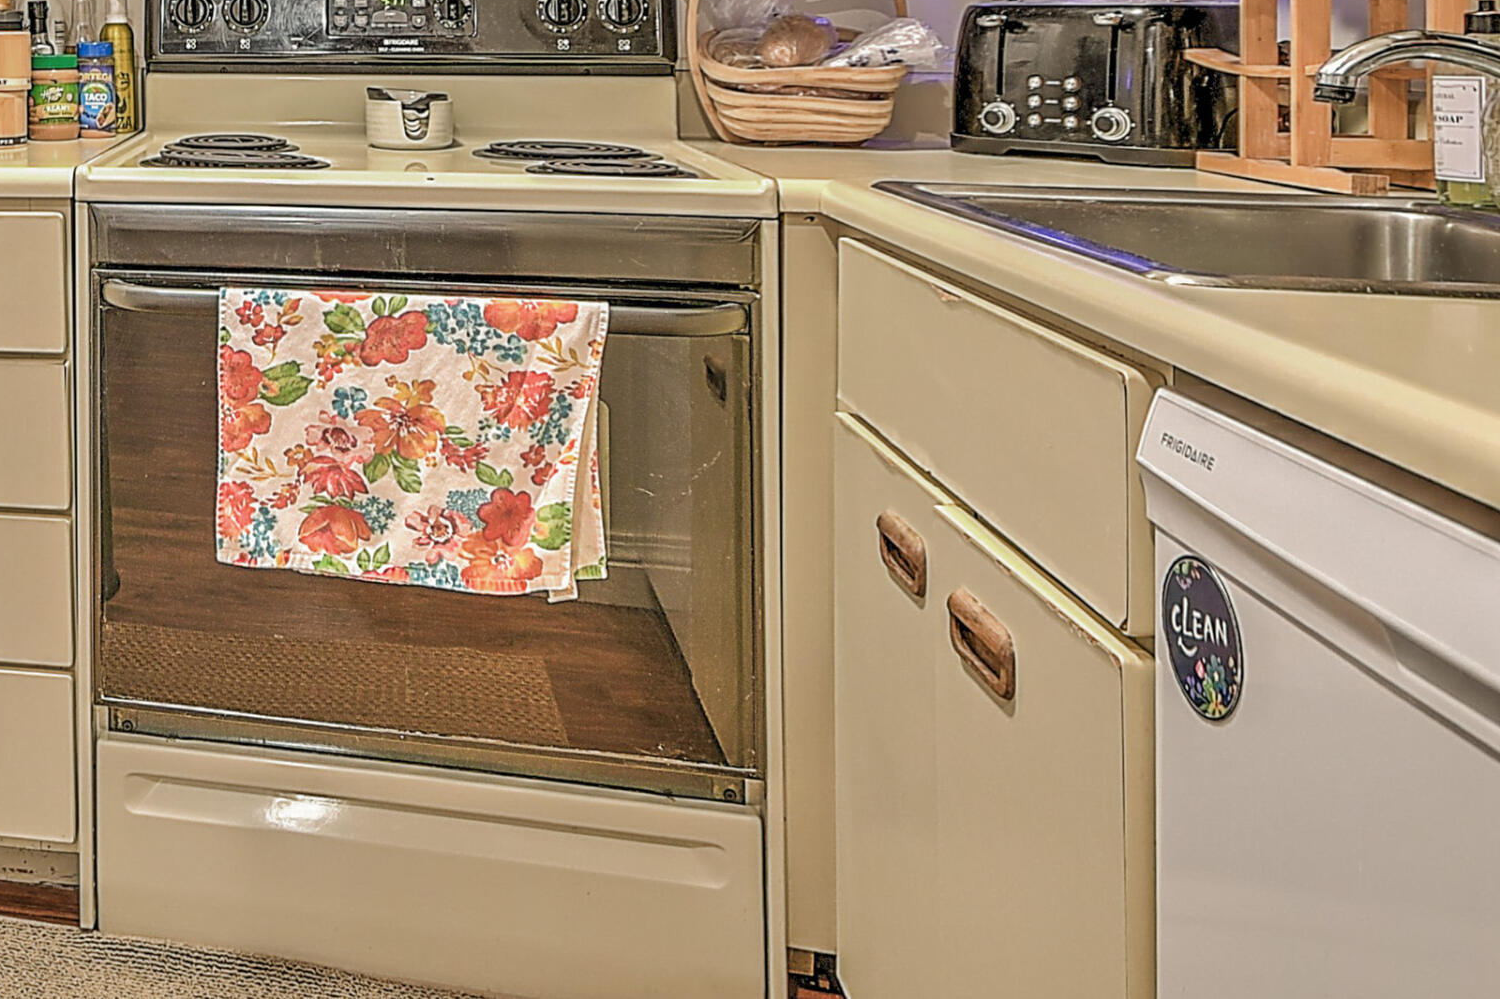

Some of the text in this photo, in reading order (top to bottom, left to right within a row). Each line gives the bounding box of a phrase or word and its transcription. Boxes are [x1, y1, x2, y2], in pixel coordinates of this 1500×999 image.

[84, 93, 108, 102] TACO
[1438, 115, 1464, 124] SOAP
[1160, 433, 1216, 471] FRIGIDAIRE
